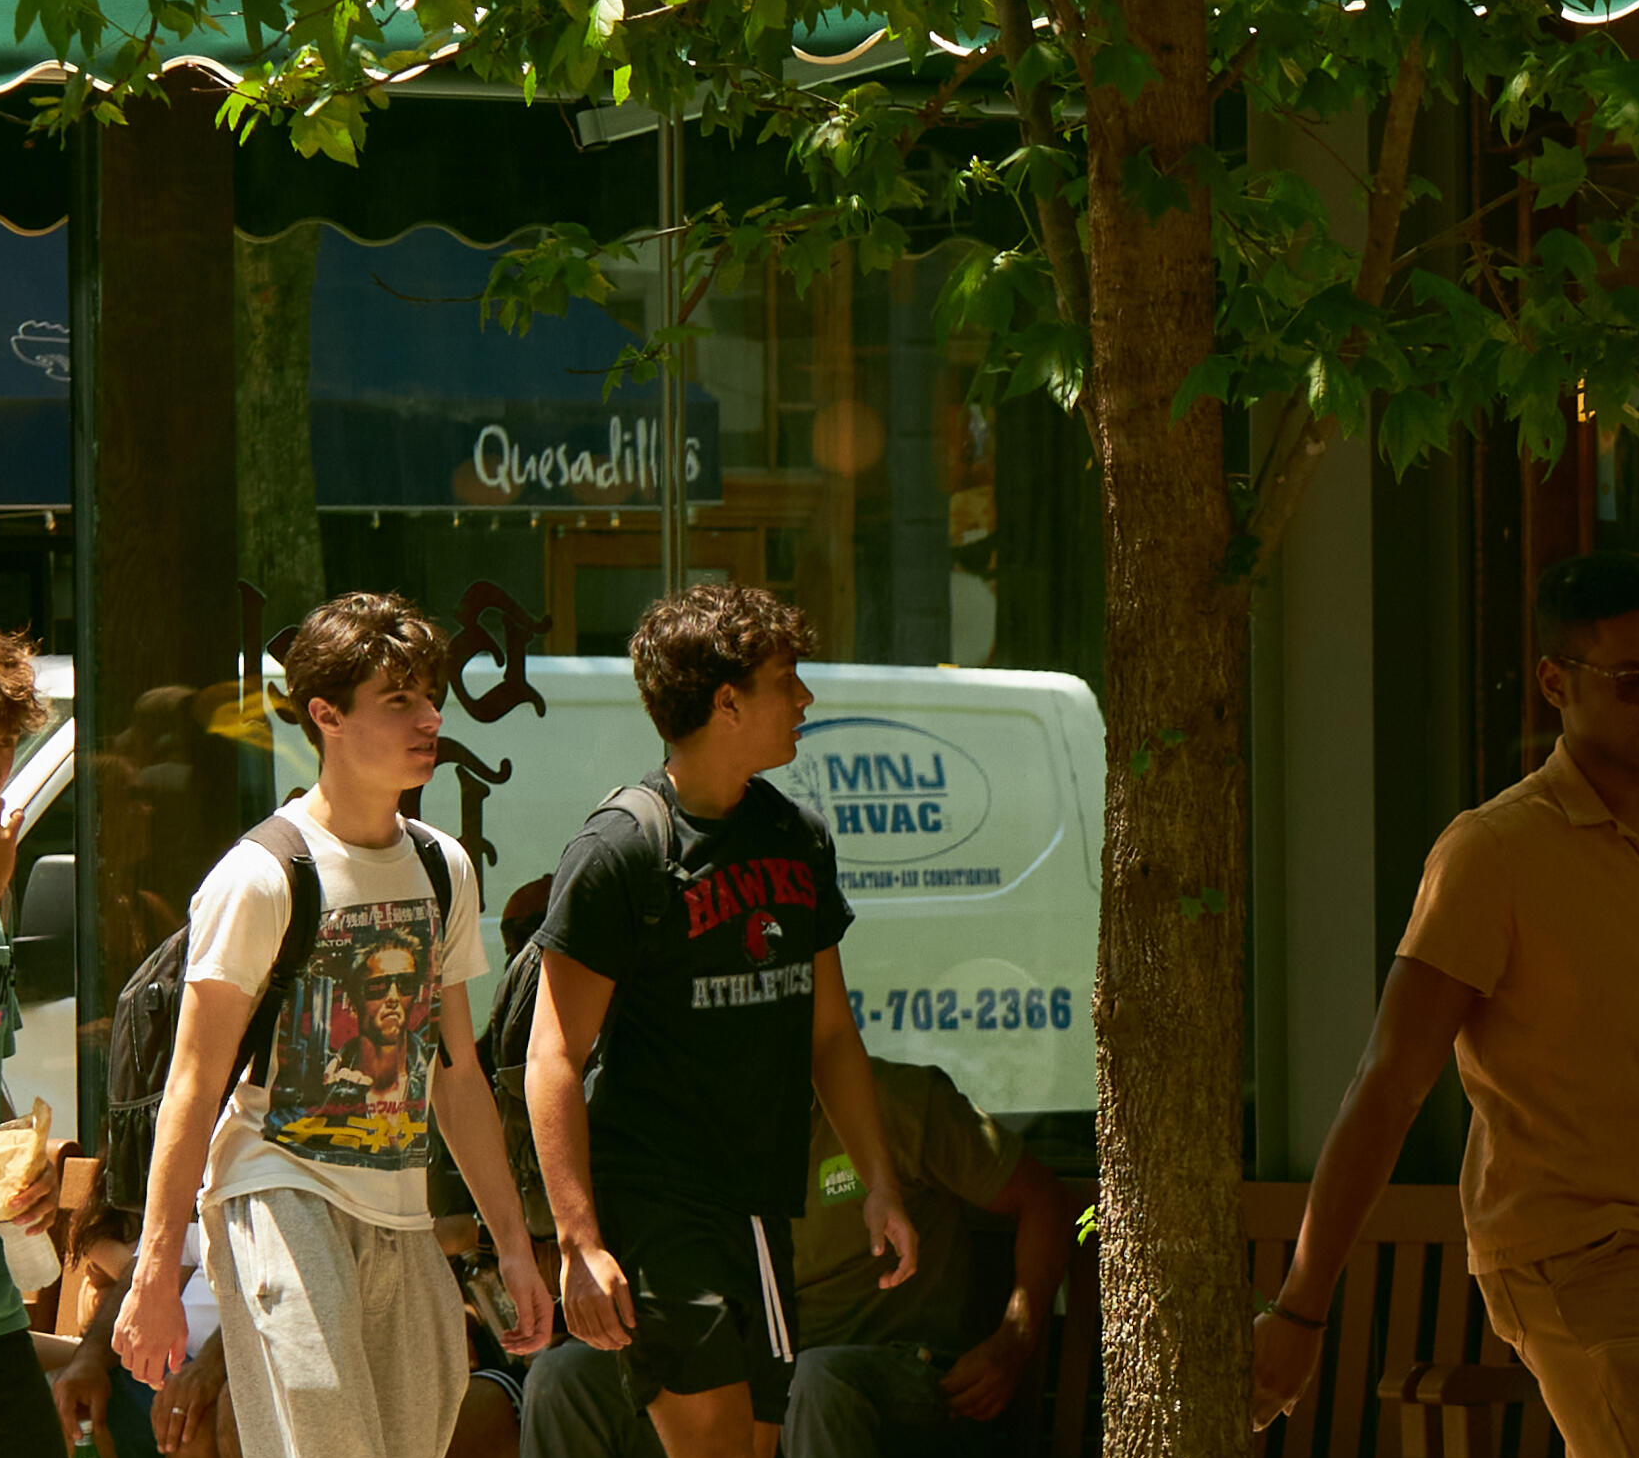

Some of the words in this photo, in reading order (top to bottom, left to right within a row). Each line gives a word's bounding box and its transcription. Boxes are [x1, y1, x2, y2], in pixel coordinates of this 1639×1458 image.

[474, 416, 701, 494] Quesadills
[825, 752, 946, 792] MNJ
[833, 801, 943, 835] HVAC
[923, 867, 1001, 888] CONDITIONING
[684, 858, 817, 939] HAWKS
[691, 962, 814, 1009] ATHLETICS
[826, 1181, 856, 1196] PLANT
